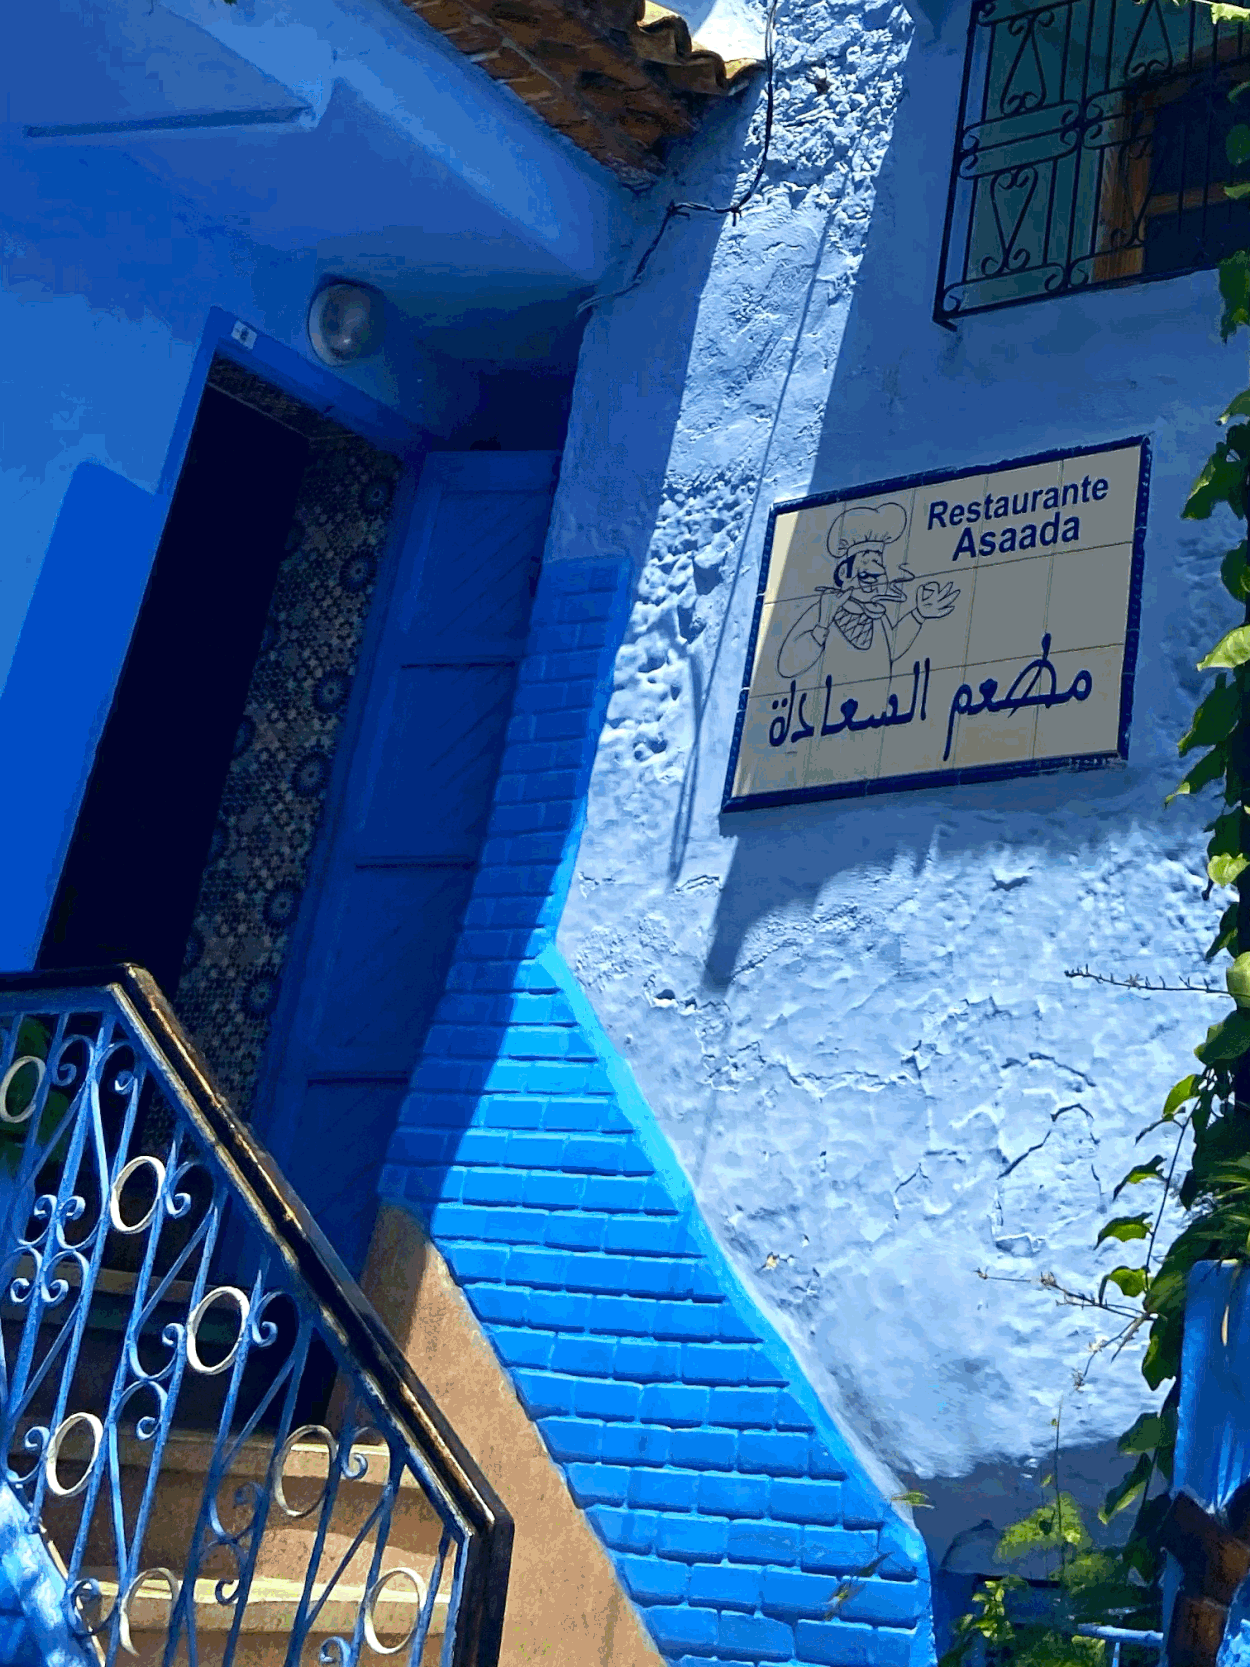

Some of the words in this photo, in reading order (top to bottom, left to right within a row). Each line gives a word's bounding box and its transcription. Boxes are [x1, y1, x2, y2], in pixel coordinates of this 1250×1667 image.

[927, 474, 1109, 531] Restaurante
[952, 510, 1081, 562] Asaada
[942, 632, 1093, 762] مطعم
